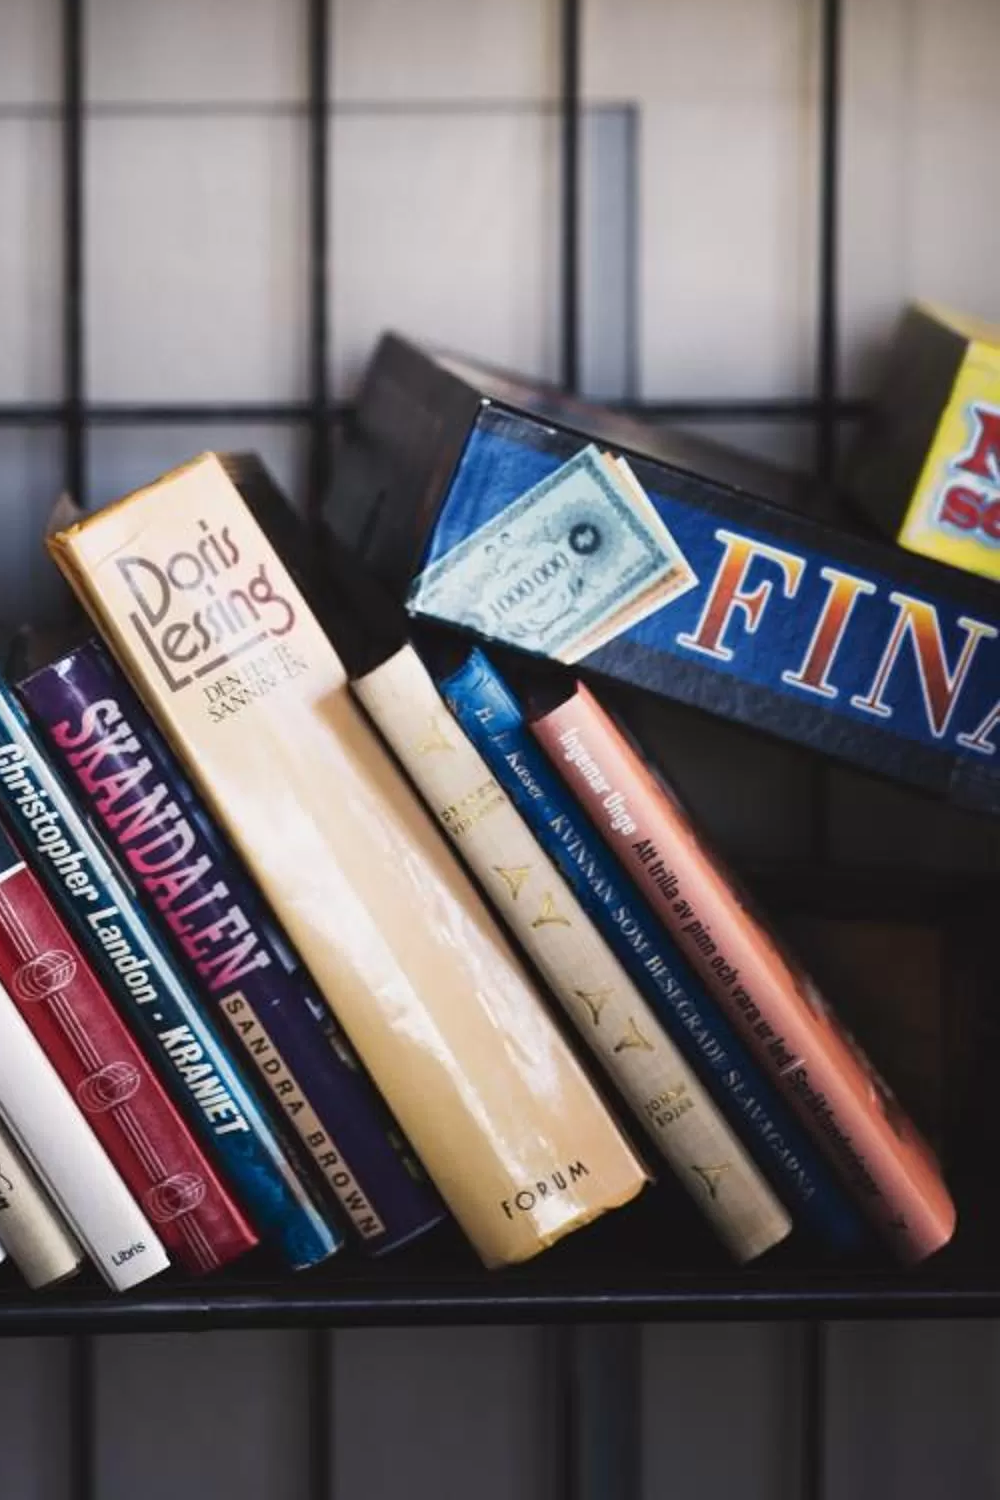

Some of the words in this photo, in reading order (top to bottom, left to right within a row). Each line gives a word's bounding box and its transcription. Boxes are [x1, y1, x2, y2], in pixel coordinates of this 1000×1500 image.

[115, 519, 240, 628] Doris
[130, 563, 296, 693] Lessing
[557, 727, 610, 796] Ingemar
[52, 698, 272, 989] SKANDALEN
[631, 838, 659, 864] Att
[647, 859, 680, 901] trilla
[672, 898, 695, 922] av
[548, 814, 612, 904] KVINNAN
[611, 906, 649, 953] SOM
[643, 954, 725, 1062] BESEGRADE
[681, 919, 718, 956] pinn
[709, 952, 740, 986] och
[86, 899, 163, 1004] Landon
[157, 1020, 253, 1135] KRANIET
[731, 985, 761, 1018] vara
[757, 1021, 775, 1039] ur
[774, 1036, 797, 1065] led
[221, 995, 310, 1116] SANDRA
[302, 1127, 384, 1239] BROWN
[500, 1158, 590, 1220] FORUM
[110, 1240, 147, 1268] Libris
